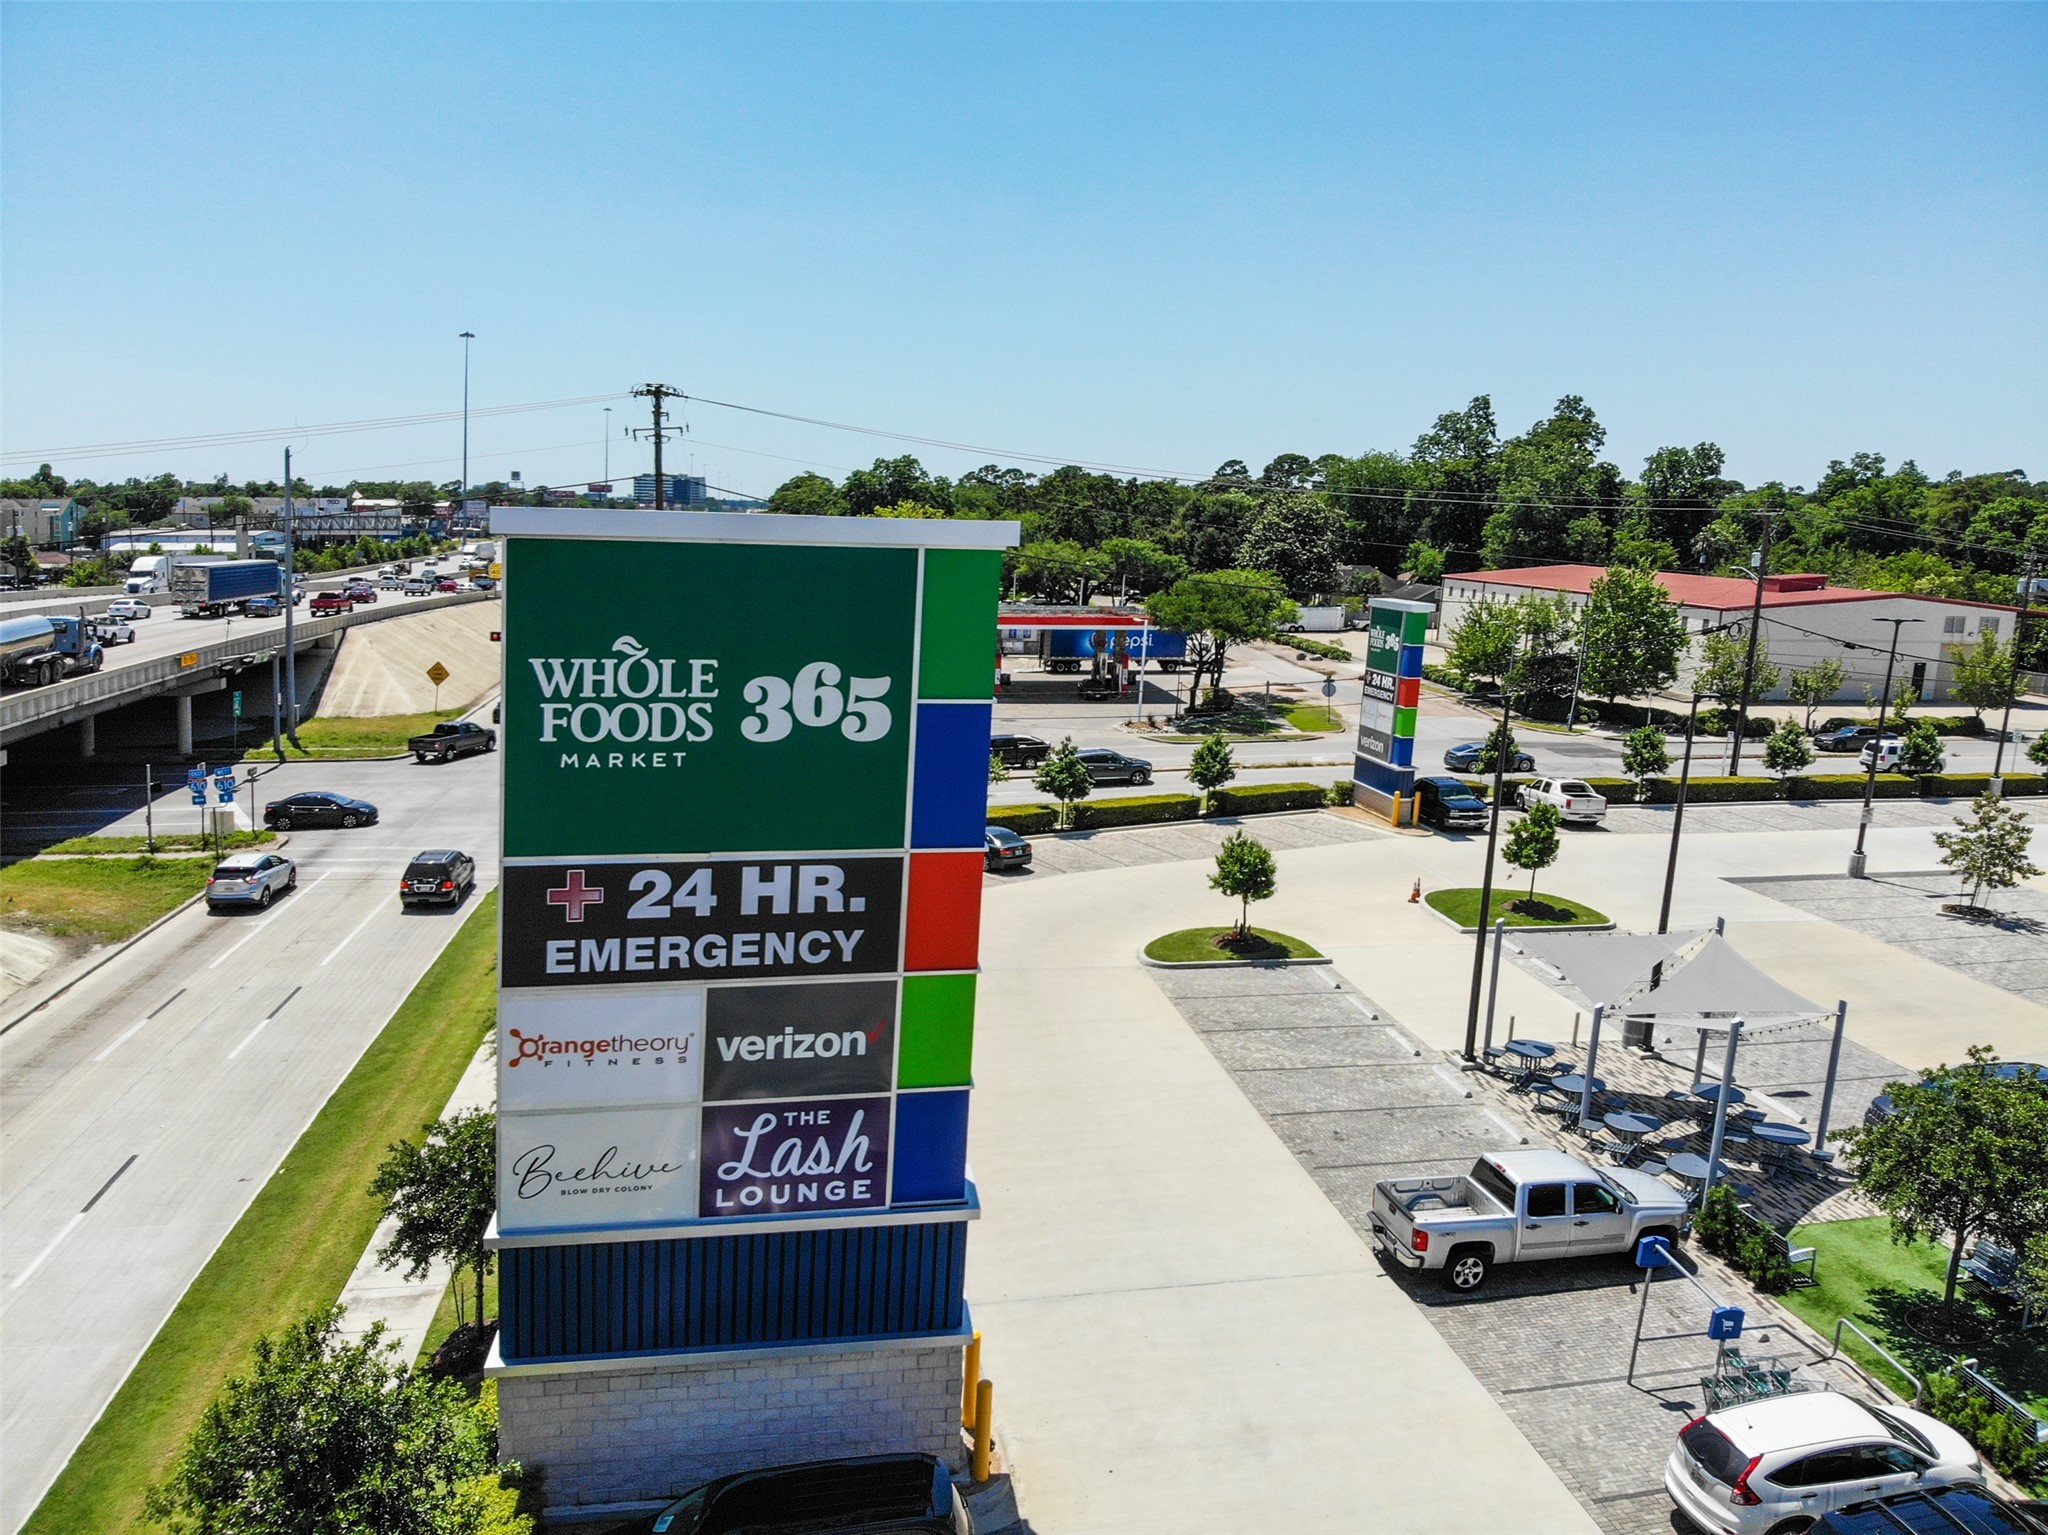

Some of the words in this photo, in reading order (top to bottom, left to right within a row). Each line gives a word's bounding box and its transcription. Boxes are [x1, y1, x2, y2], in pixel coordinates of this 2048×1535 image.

[1385, 633, 1400, 651] 365
[528, 656, 720, 698] WHOLE
[1371, 673, 1382, 687] 24
[1381, 675, 1395, 690] HR.
[740, 661, 892, 743] 365
[1364, 685, 1394, 702] EMERGENCY
[539, 702, 713, 743] FOODS
[1360, 735, 1384, 753] verizon
[560, 752, 688, 769] MARKET
[191, 782, 206, 791] 610
[217, 780, 234, 789] 610
[626, 868, 718, 920] 24
[740, 864, 867, 916] HR.
[545, 929, 866, 975] EMERGENCY
[716, 1026, 867, 1062] verizon
[544, 1056, 688, 1068] FITNESS
[783, 1110, 831, 1127] THE
[717, 1109, 873, 1181] Lash
[512, 1144, 683, 1199] Beehive
[560, 1187, 589, 1196] BLOW
[715, 1179, 872, 1208] LOUNGE
